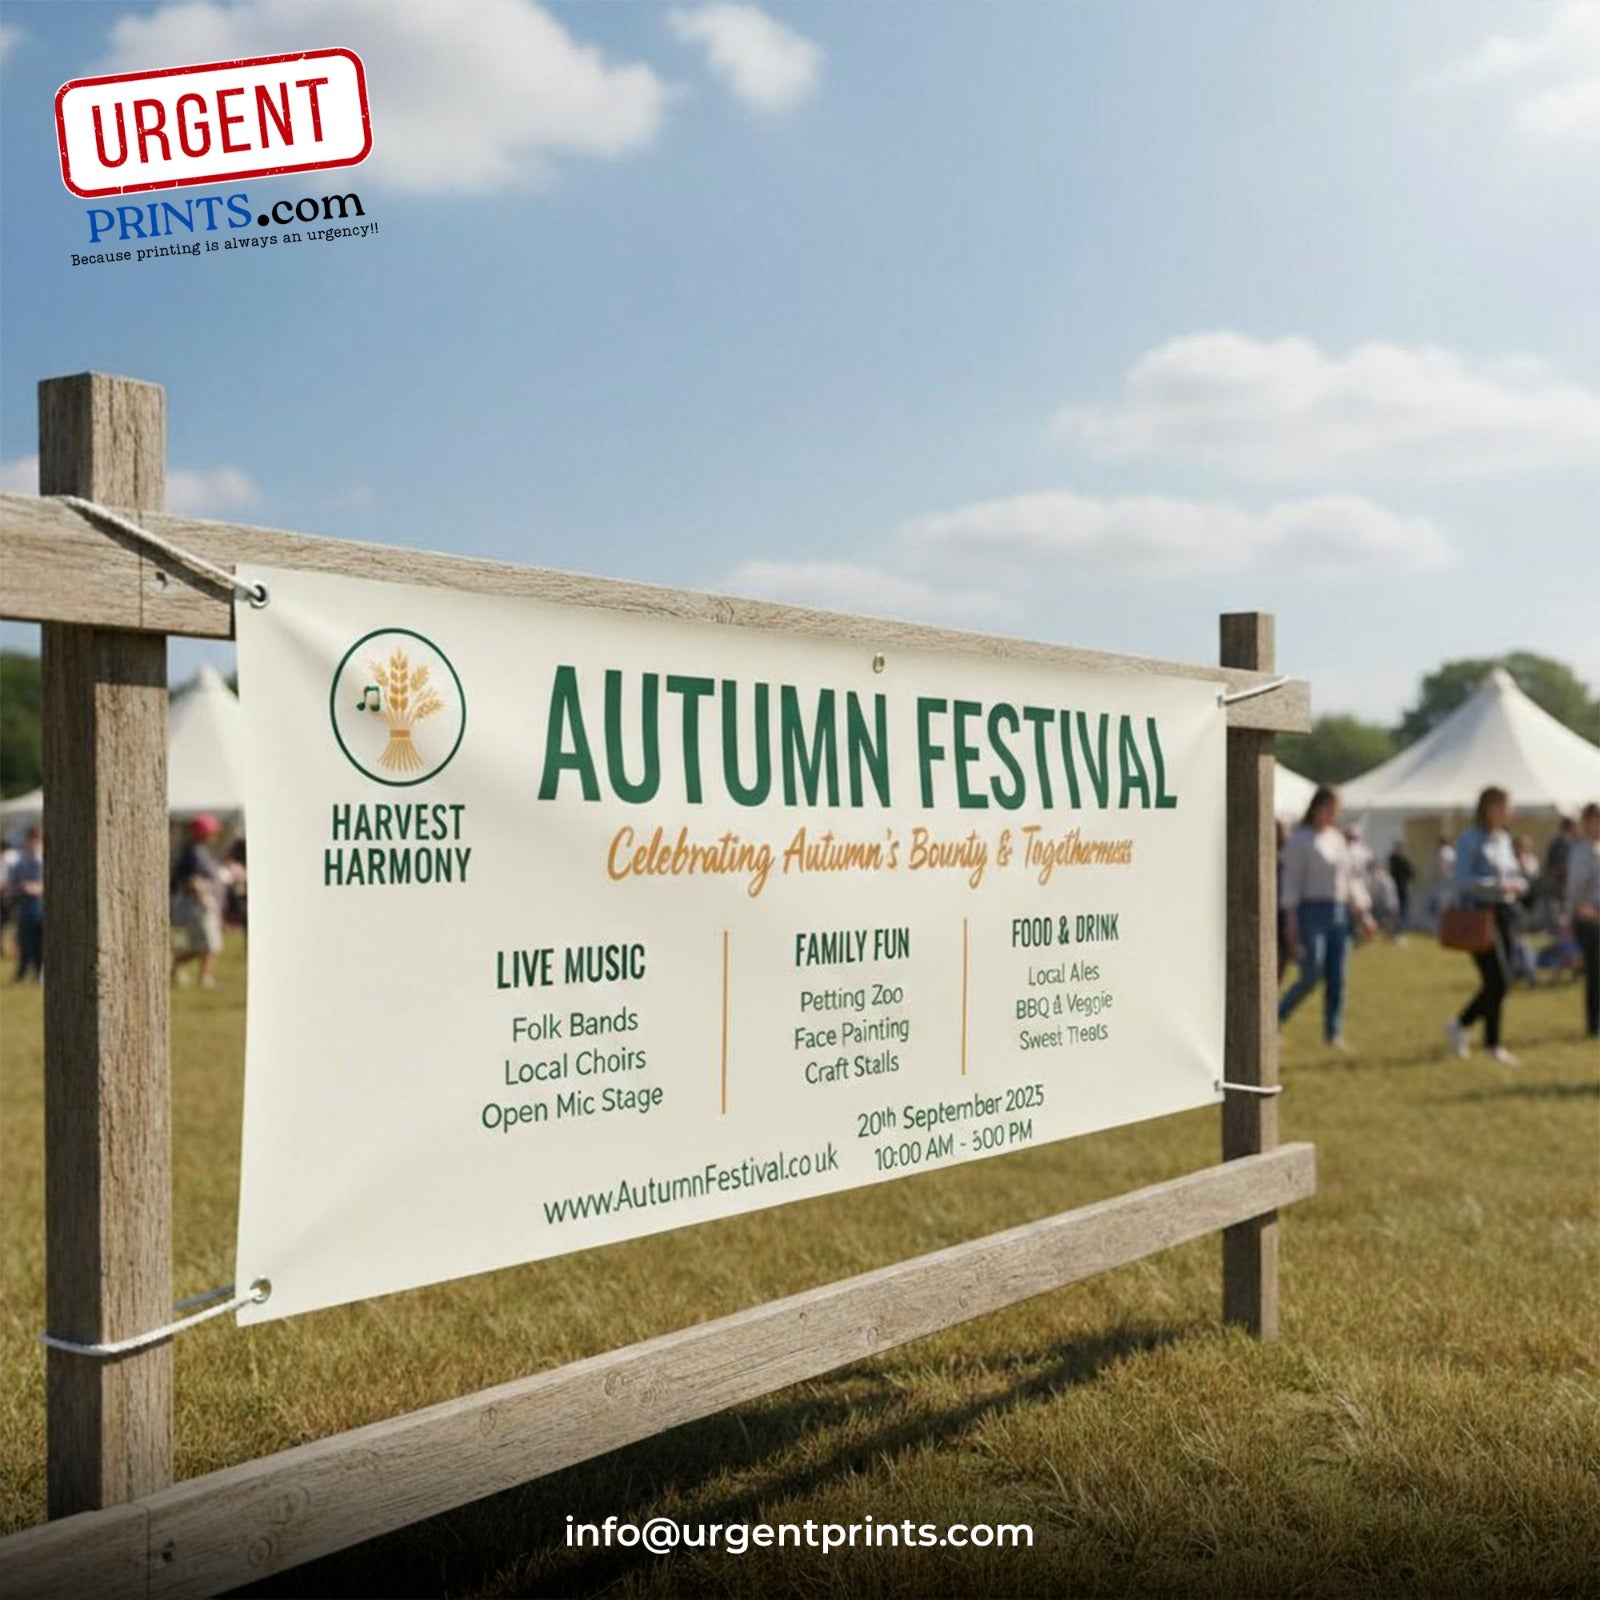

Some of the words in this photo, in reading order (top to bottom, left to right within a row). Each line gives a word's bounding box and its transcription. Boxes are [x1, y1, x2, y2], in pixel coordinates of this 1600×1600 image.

[538, 665, 891, 807] AUTUMN
[917, 696, 1178, 810] FESTIVAL
[332, 804, 465, 841] HARVEST
[324, 847, 472, 886] HARMONY
[607, 826, 776, 898] Celebrating
[782, 826, 899, 876] Autumn's
[908, 827, 988, 889] Bounty
[795, 930, 867, 967] FAMILY
[873, 927, 910, 961] FUN
[1012, 917, 1052, 948] FOOD
[1076, 913, 1119, 942] DRINK
[497, 949, 554, 989] LIVE
[564, 943, 646, 984] MUSIC
[1070, 961, 1100, 982] Ales
[801, 989, 865, 1012] Petting
[871, 985, 904, 1006] Zoo
[1016, 996, 1049, 1019] BBQ
[513, 1013, 562, 1042] Folk
[570, 1006, 638, 1037] Bands
[795, 1027, 836, 1049] Face
[842, 1017, 909, 1045] Painting
[505, 1052, 567, 1085] Local
[576, 1047, 646, 1075] Choirs
[805, 1058, 849, 1083] Craft
[854, 1050, 899, 1076] Stalls
[482, 1102, 548, 1133] Open
[557, 1090, 595, 1118] Mic
[602, 1087, 663, 1113] Stage
[858, 1107, 896, 1137] 20th
[903, 1094, 1001, 1130] September
[1006, 1084, 1045, 1111] 2025
[875, 1141, 922, 1170] 10:00
[926, 1135, 953, 1160] AM
[1009, 1118, 1032, 1143] PM
